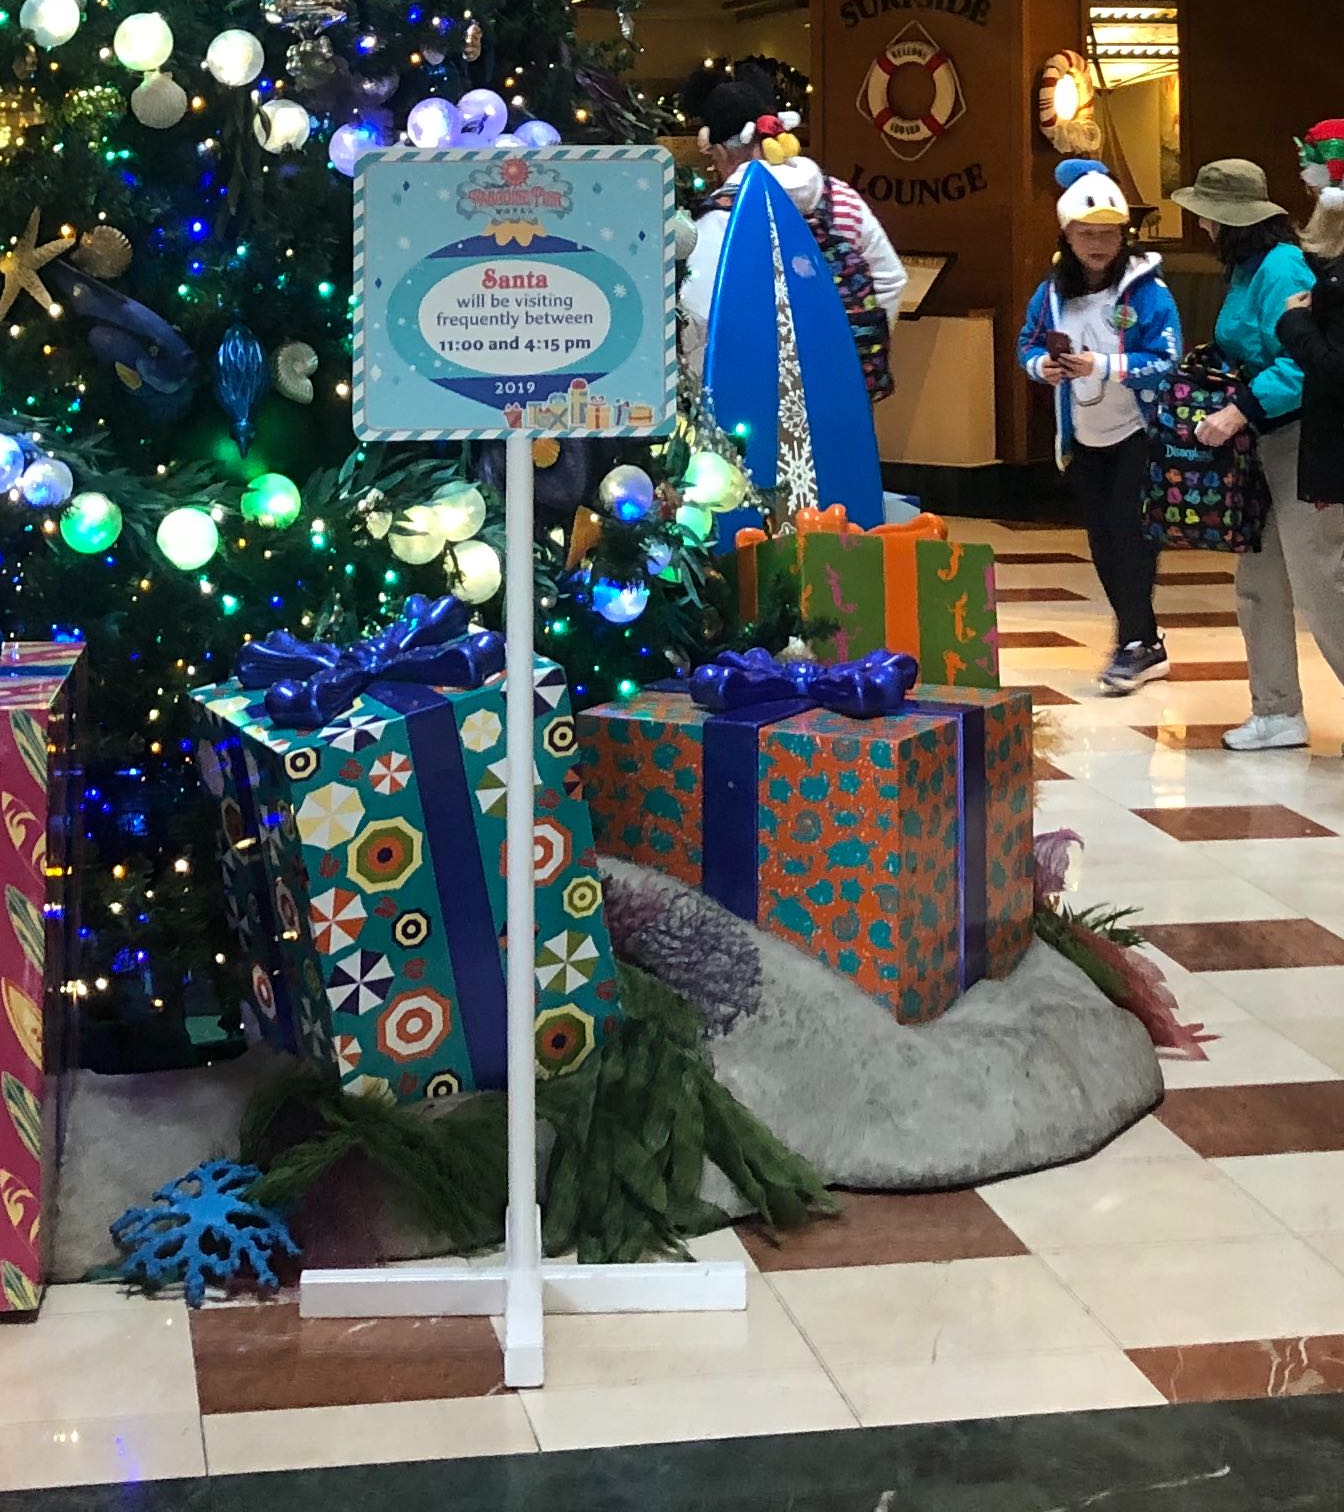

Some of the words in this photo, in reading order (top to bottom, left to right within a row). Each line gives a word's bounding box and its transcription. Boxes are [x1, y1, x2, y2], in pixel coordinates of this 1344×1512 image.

[850, 162, 988, 206] LOUNGE
[481, 268, 549, 290] Santa
[456, 293, 487, 309] will
[490, 293, 510, 309] be
[515, 293, 574, 311] visiting
[436, 311, 520, 330] frequently
[524, 311, 594, 326] between
[439, 338, 484, 353] 11:00
[488, 335, 520, 351] and
[524, 337, 560, 353] 4:15
[564, 337, 592, 354] pm
[494, 381, 537, 395] 2019
